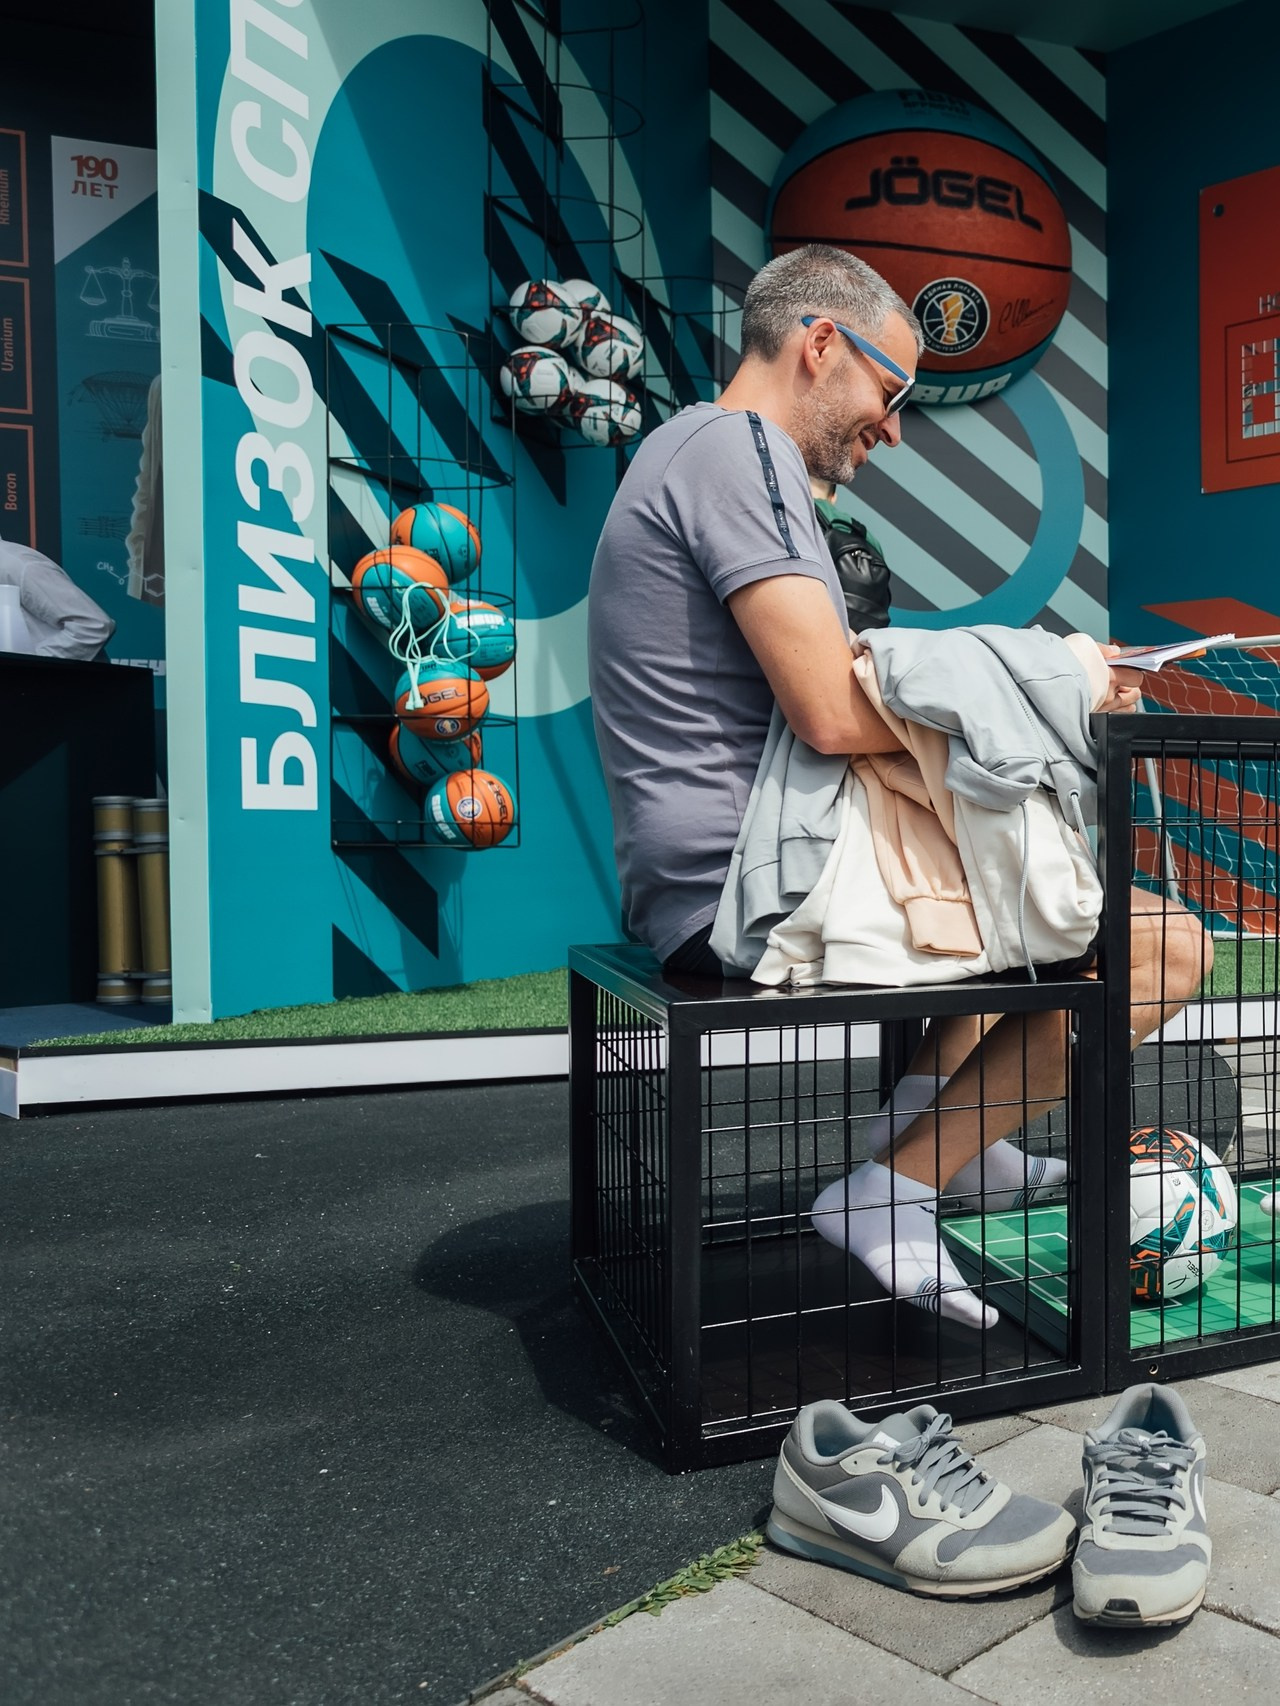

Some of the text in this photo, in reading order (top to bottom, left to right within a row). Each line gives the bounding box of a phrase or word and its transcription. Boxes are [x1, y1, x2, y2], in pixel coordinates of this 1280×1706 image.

[70, 155, 119, 181] 190
[72, 180, 119, 199] ЛЕТ
[845, 156, 1043, 234] JÖGEL
[1, 317, 14, 372] Uranium
[230, 0, 318, 811] БЛИЗОК СП
[4, 472, 17, 511] Boron
